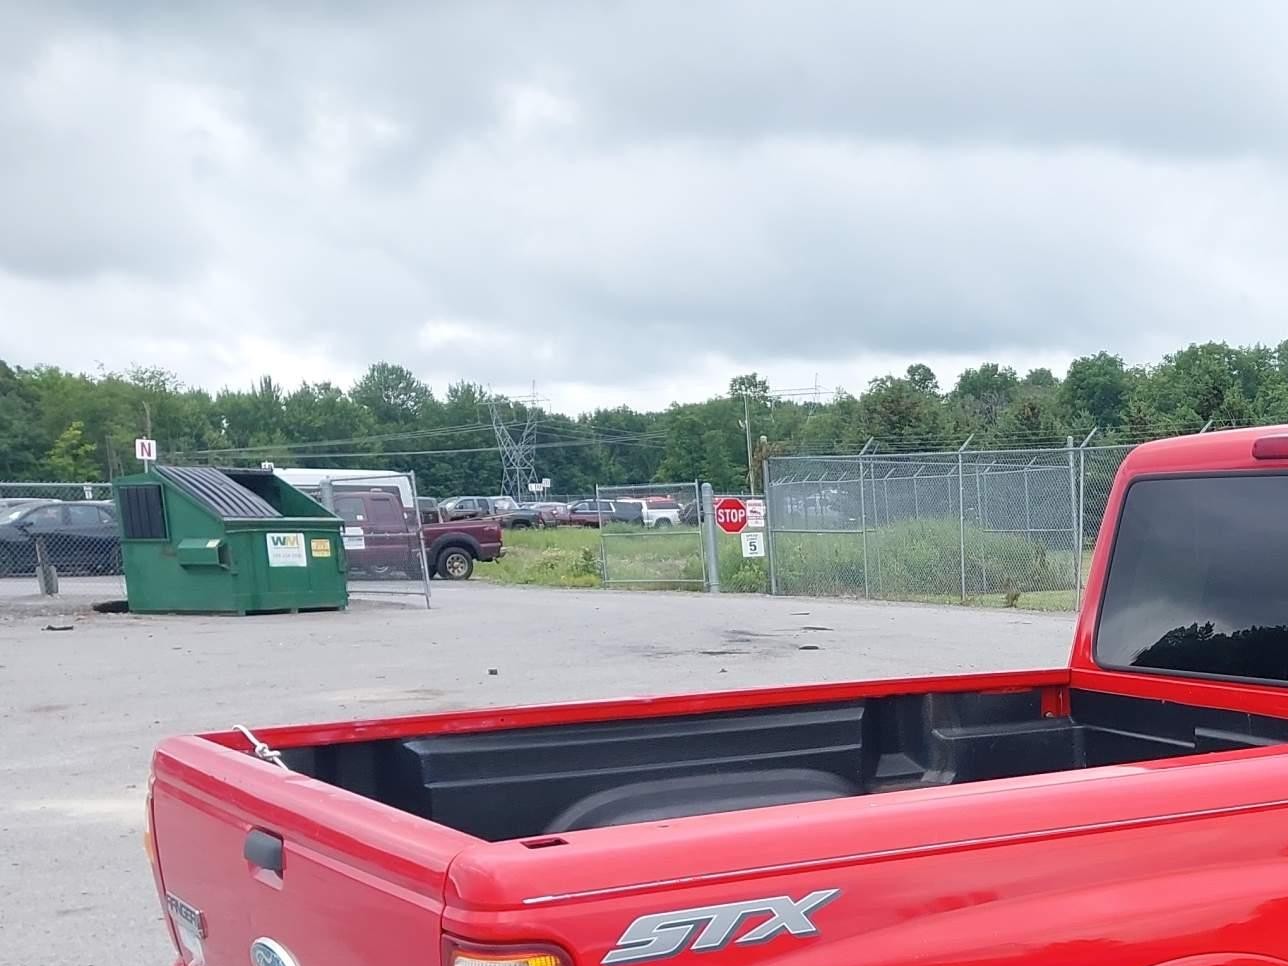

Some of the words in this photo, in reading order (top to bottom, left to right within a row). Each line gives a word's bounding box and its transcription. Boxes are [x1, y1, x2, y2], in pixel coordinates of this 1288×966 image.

[141, 442, 151, 457] N
[718, 509, 746, 522] STOP
[749, 541, 757, 551] 5
